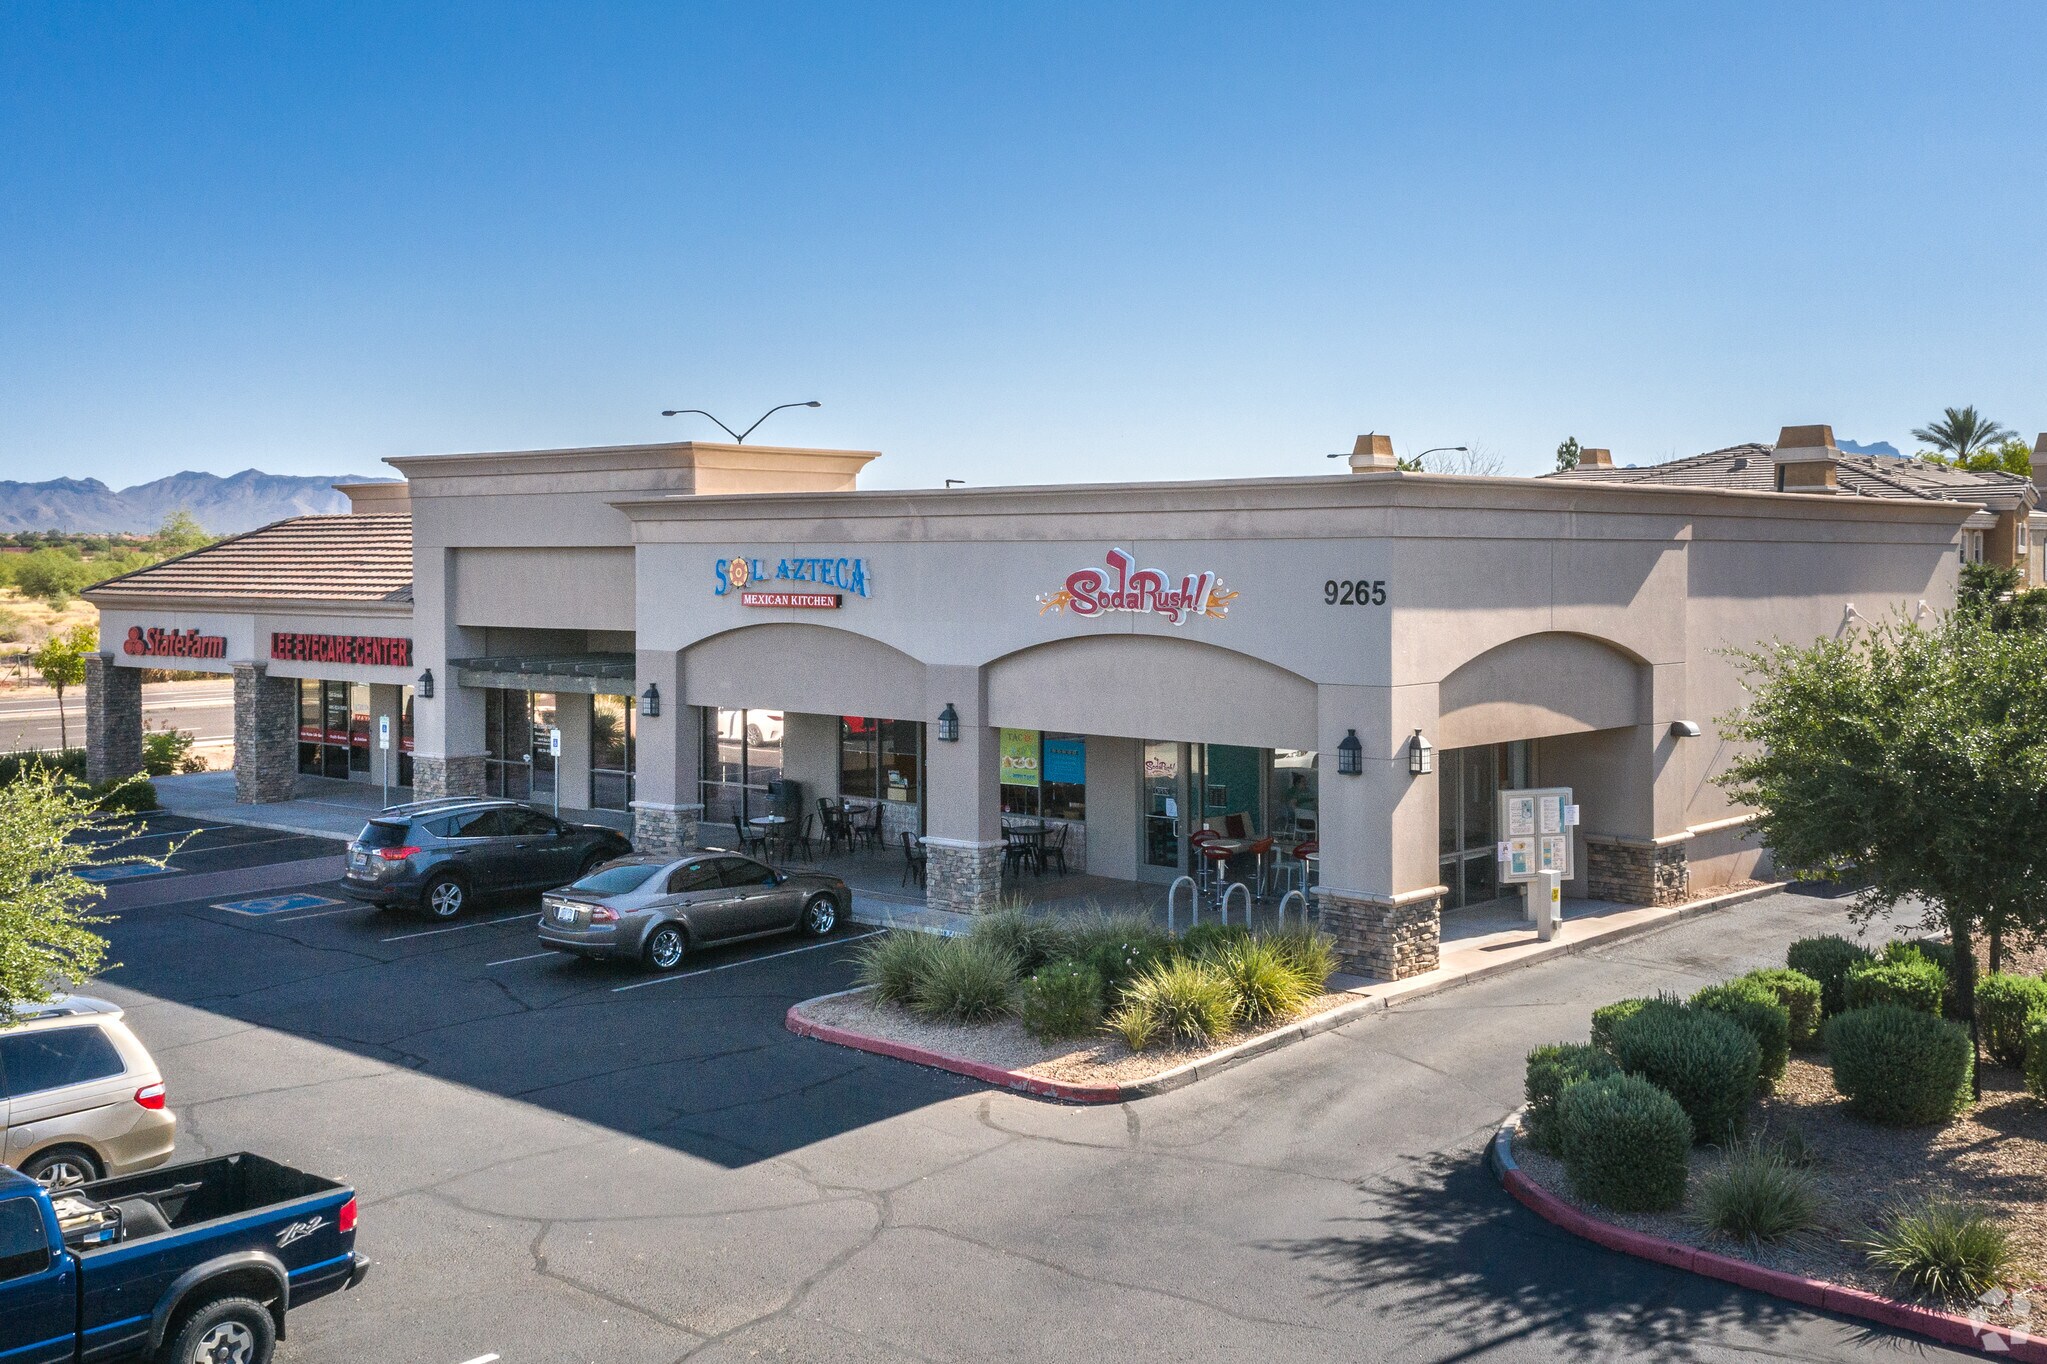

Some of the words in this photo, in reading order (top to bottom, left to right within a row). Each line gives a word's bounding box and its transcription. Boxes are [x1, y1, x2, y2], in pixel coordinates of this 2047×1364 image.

[715, 557, 765, 596] SOL
[775, 558, 868, 598] AZTECA
[743, 594, 789, 605] MEXICAN
[791, 595, 834, 607] KITCHEN
[1324, 580, 1387, 606] 9265
[271, 633, 292, 660] LEE
[295, 634, 352, 664] EYECARE
[355, 636, 408, 667] CENTER
